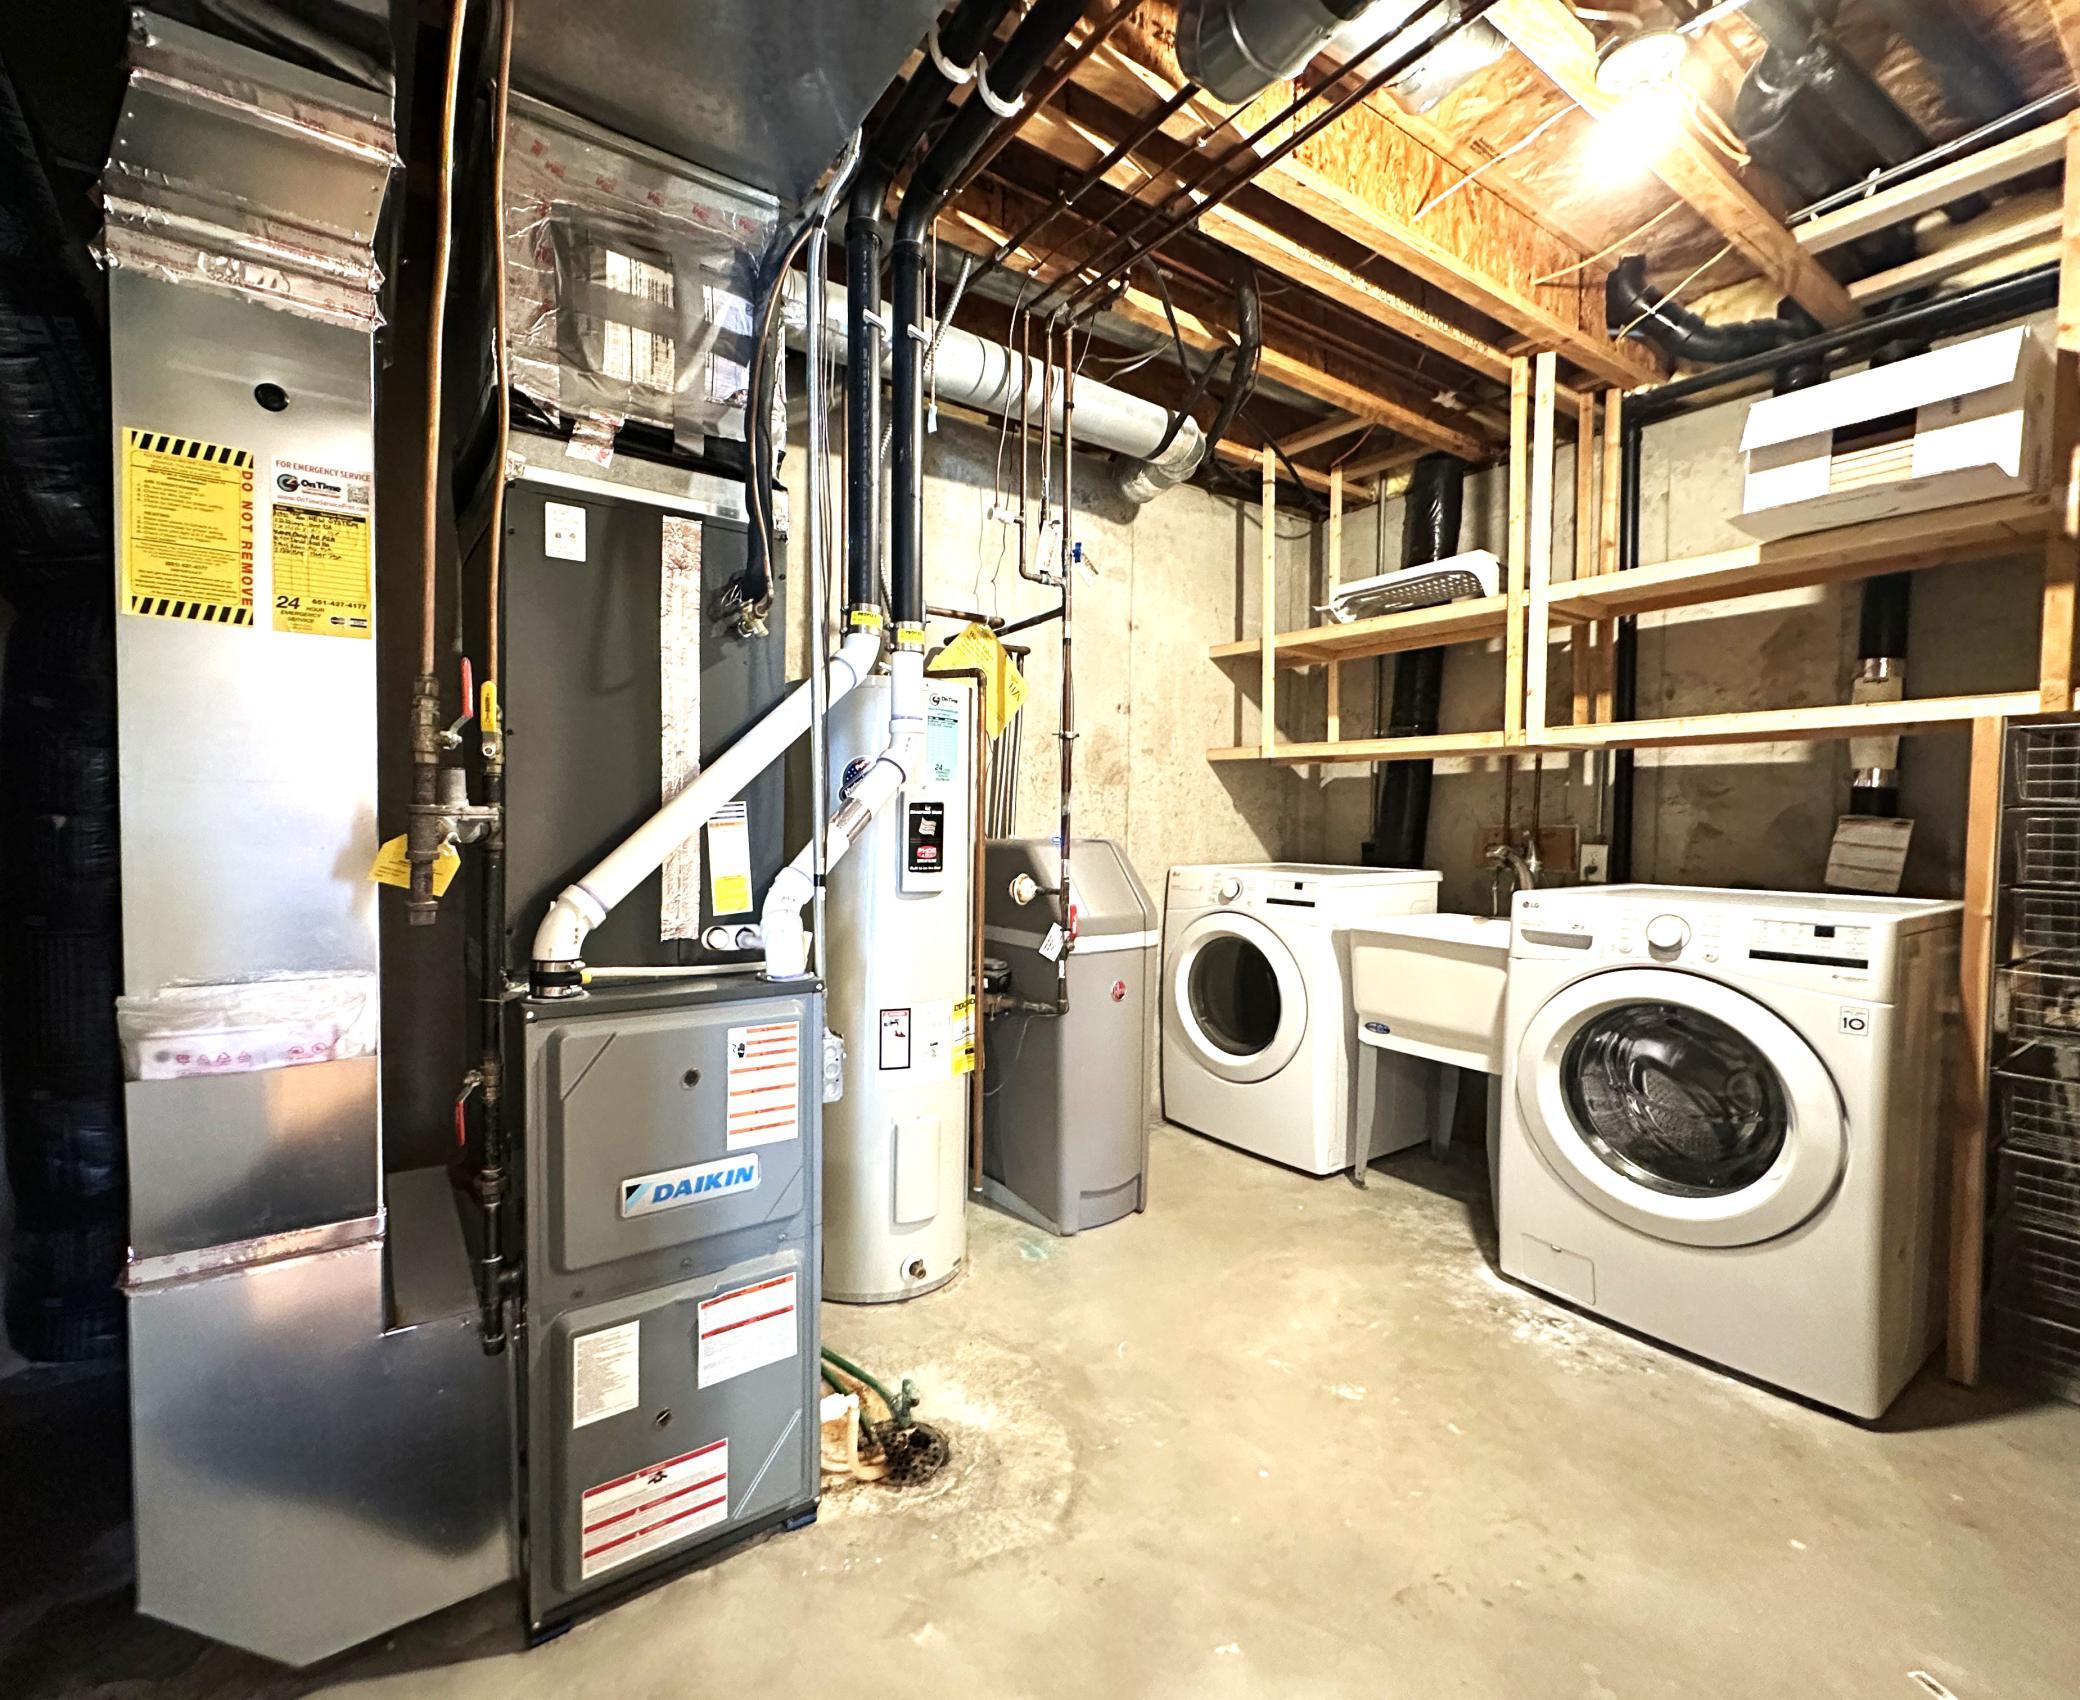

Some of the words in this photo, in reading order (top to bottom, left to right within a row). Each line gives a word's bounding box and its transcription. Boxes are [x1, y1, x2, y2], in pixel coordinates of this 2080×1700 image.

[241, 470, 254, 492] DO
[275, 459, 292, 469] FOR
[293, 462, 339, 477] EMERGENCY
[340, 470, 371, 482] SERVICE
[241, 500, 254, 533] NOT
[241, 540, 254, 606] REMOVE
[276, 595, 301, 610] 24
[934, 763, 943, 771] 24
[652, 1164, 755, 1204] DAIKIN
